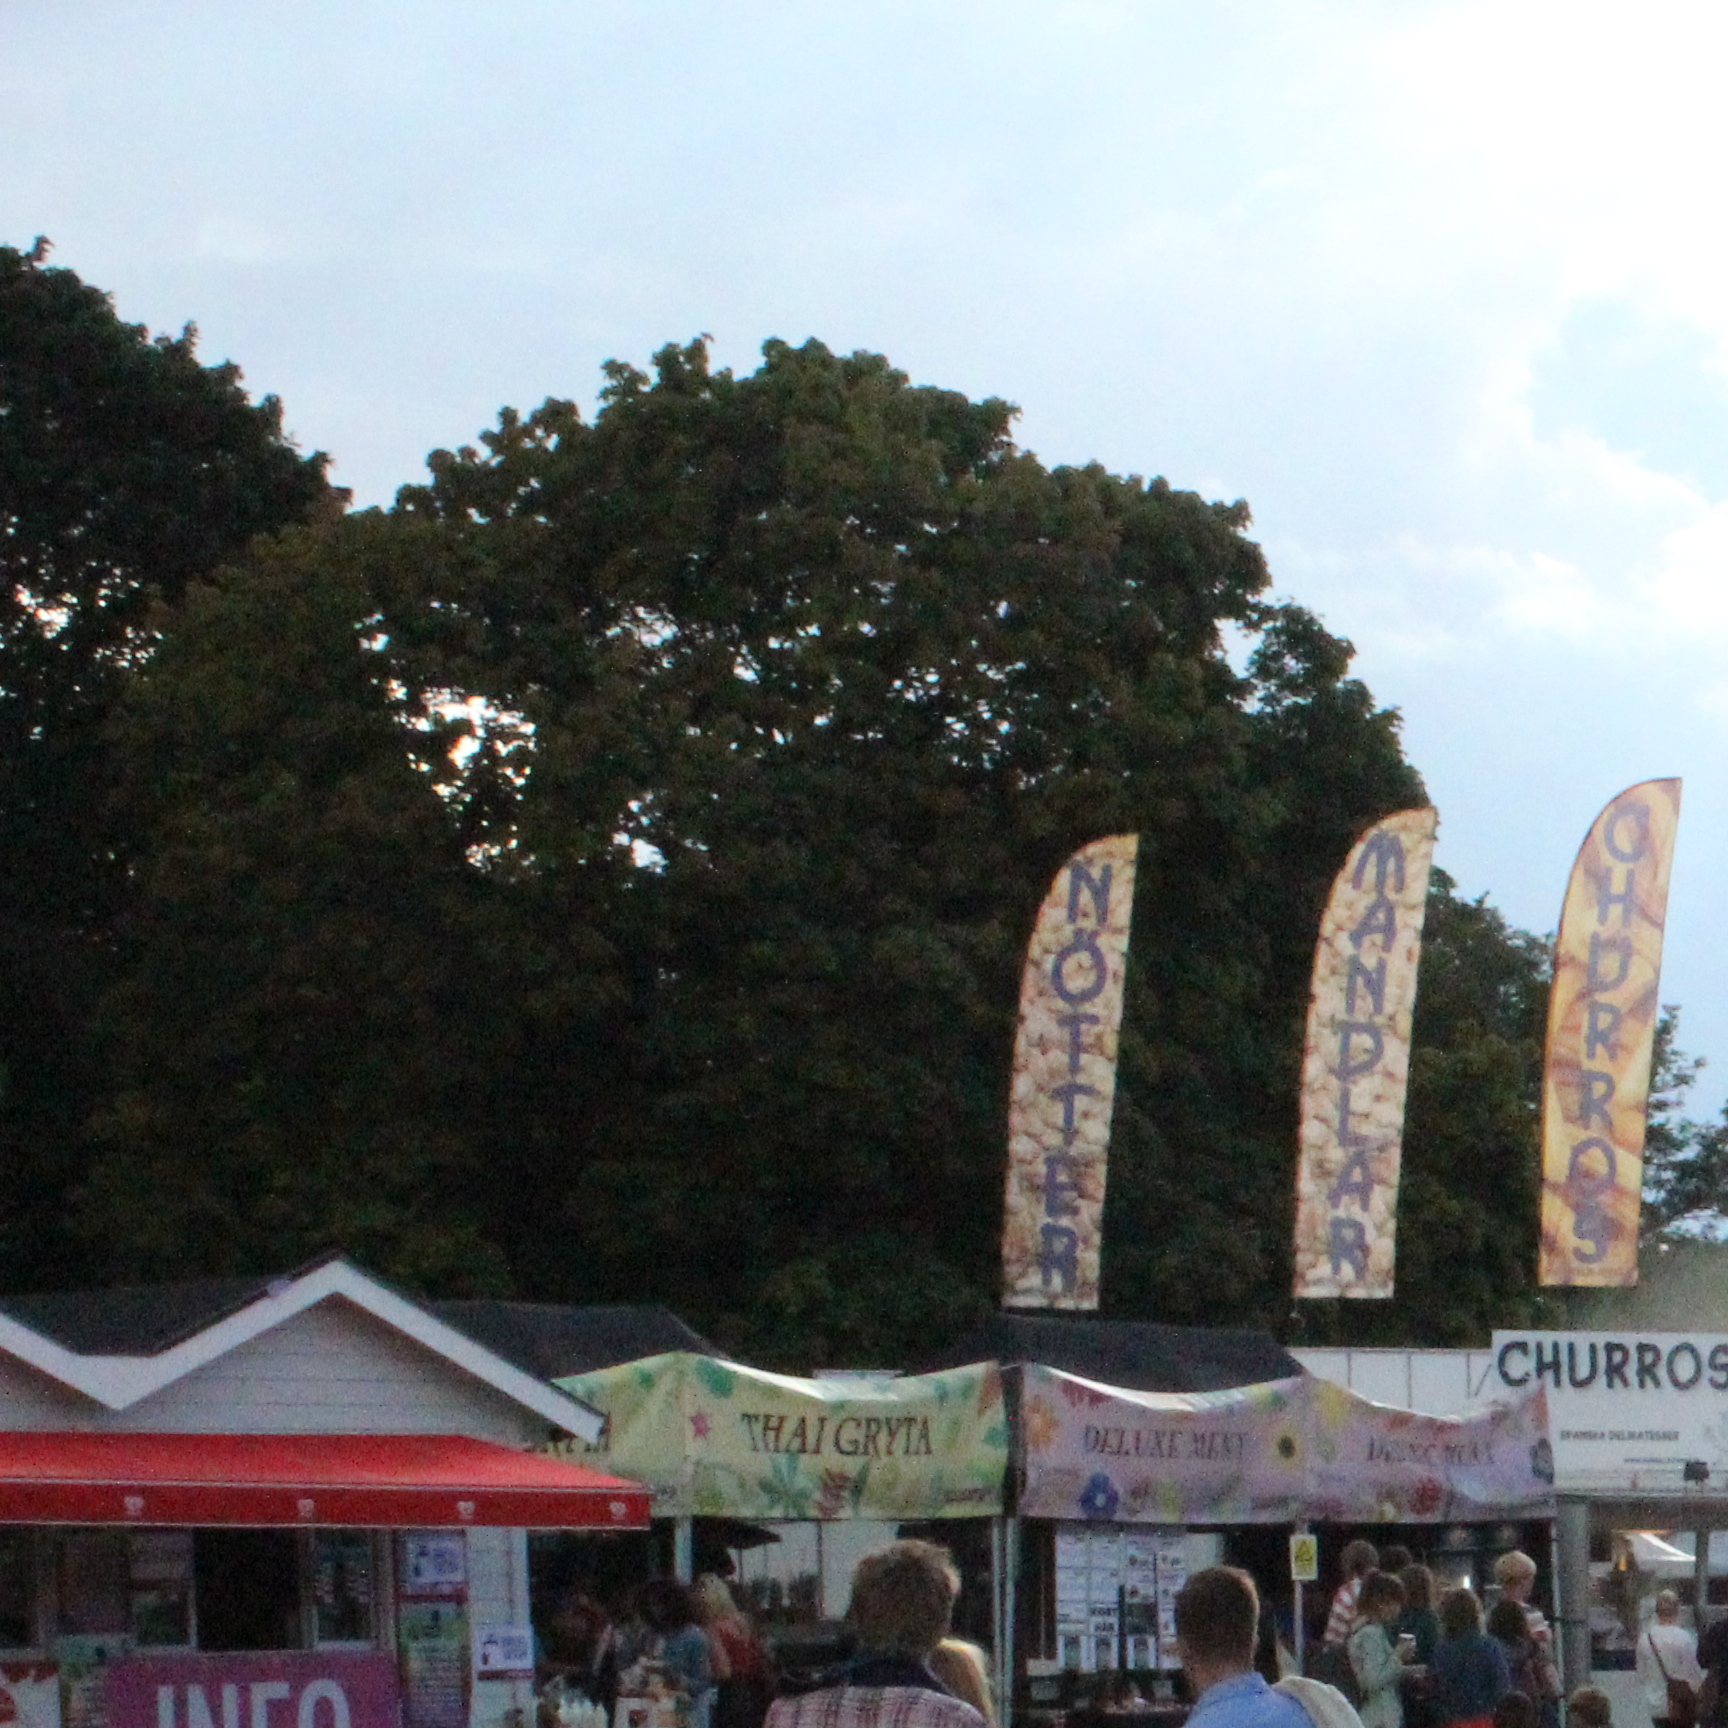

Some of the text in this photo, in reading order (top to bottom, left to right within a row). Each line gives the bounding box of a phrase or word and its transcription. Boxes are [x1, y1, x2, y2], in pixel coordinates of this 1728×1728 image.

[1040, 861, 1112, 1294] NÖTTER
[1328, 829, 1405, 1280] MANDLAR
[741, 1413, 933, 1459] THAI GRYTA
